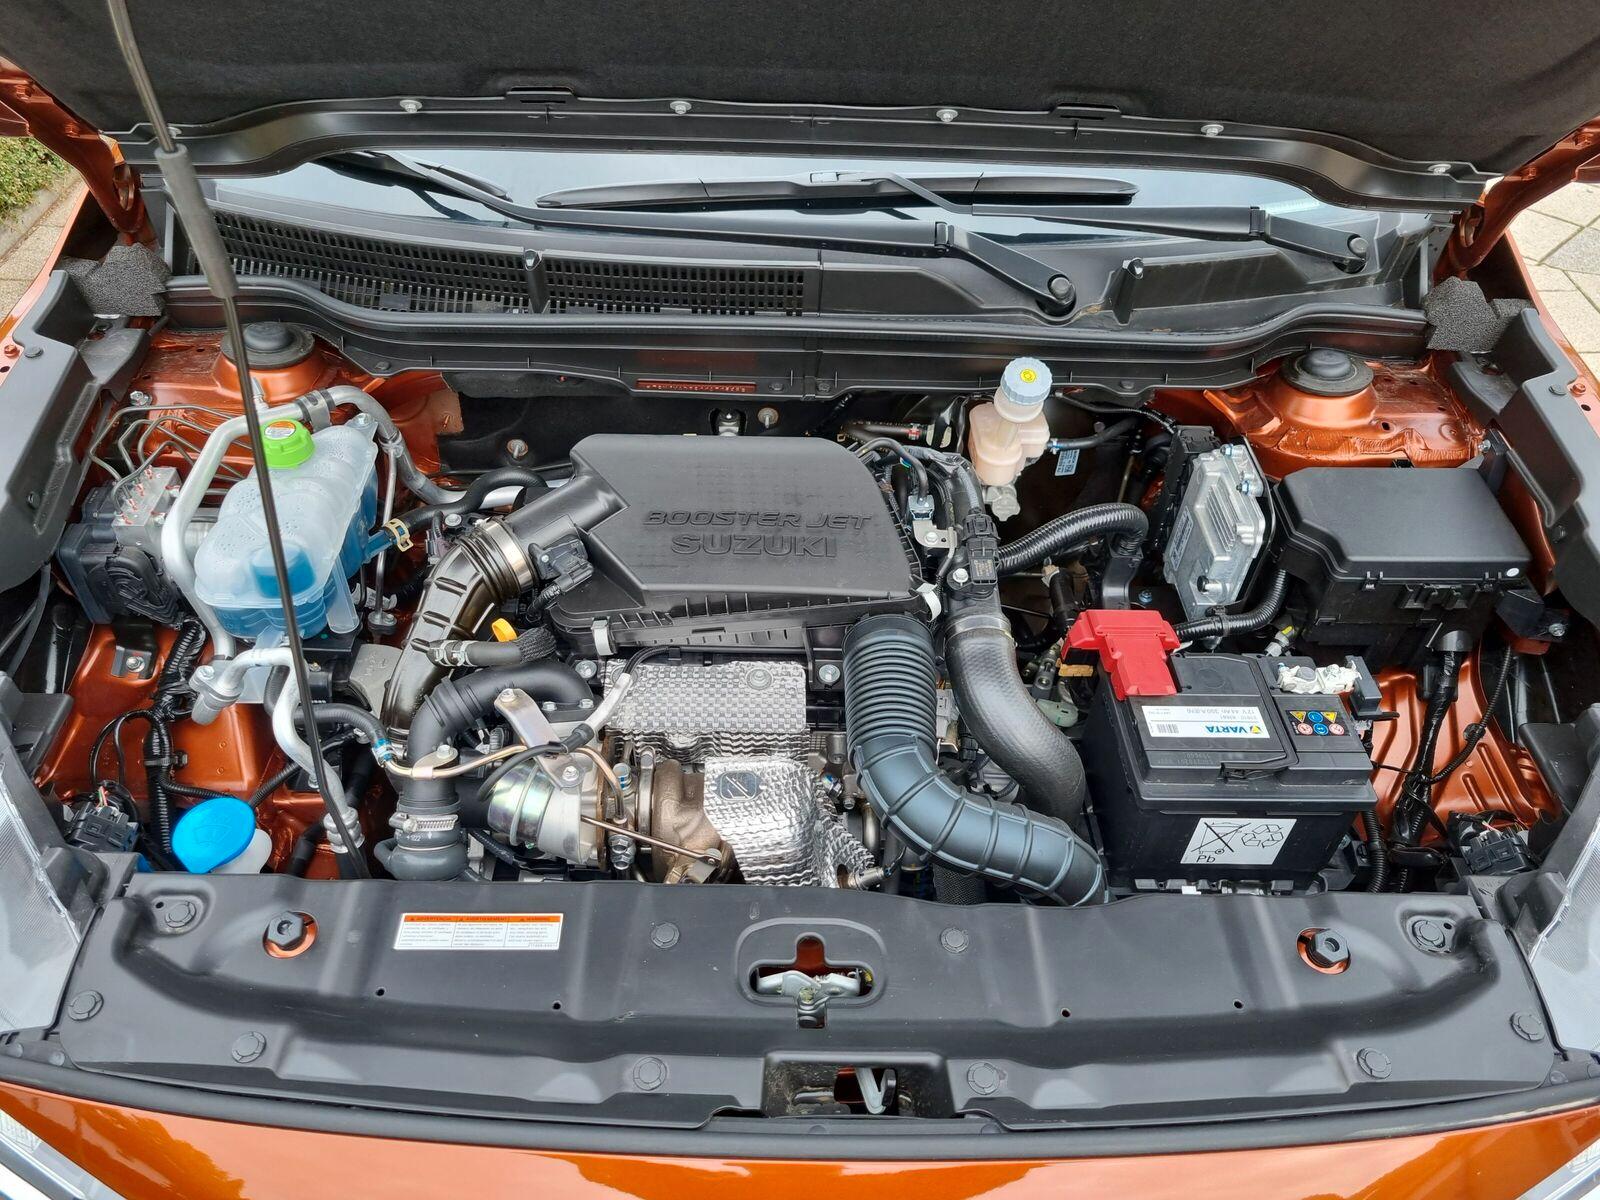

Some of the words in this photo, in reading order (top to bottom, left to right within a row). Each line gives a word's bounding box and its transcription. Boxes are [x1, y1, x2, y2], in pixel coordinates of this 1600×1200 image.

[643, 510, 801, 528] BOOSTER
[805, 513, 873, 529] JET
[671, 533, 838, 557] SUZUKI
[1205, 725, 1248, 734] VARTA
[1196, 854, 1216, 863] Pb
